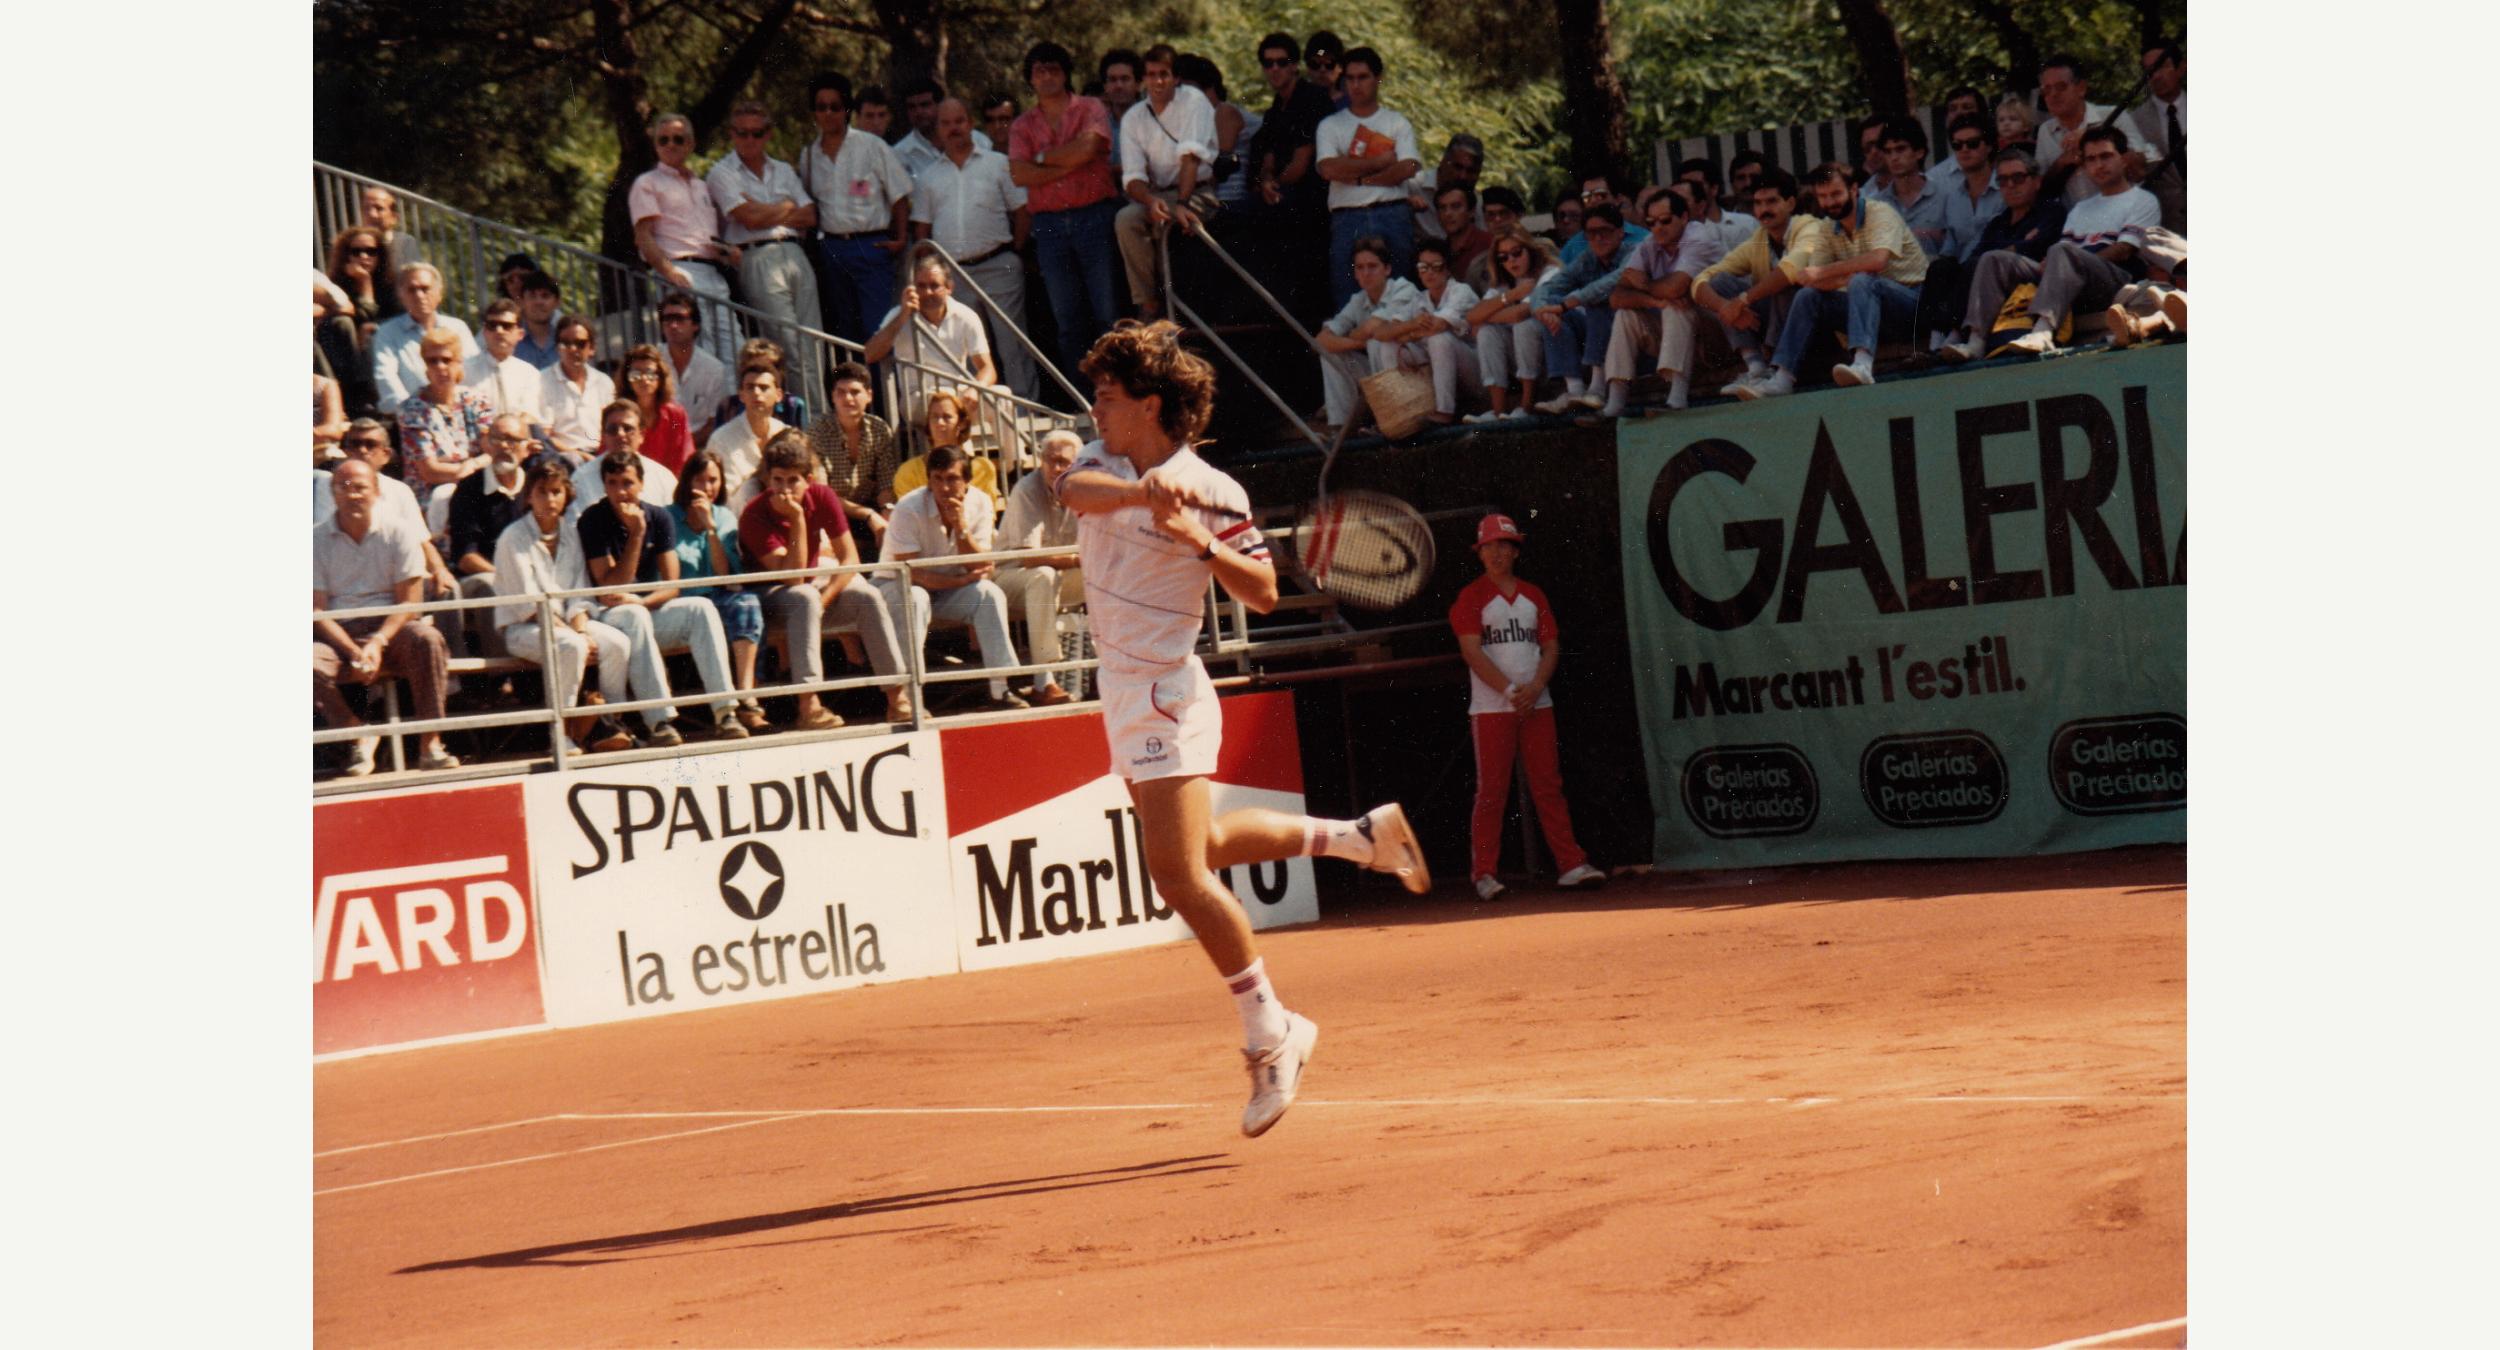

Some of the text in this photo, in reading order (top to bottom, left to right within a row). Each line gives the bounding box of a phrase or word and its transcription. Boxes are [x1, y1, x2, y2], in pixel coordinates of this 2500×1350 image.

[1672, 655, 1865, 720] Marcant
[566, 743, 918, 881] SPALDING
[1702, 793, 1806, 821] Preciados
[1879, 780, 1994, 812] Preciados
[2067, 763, 2187, 800] Preciado
[967, 806, 1289, 948] Marlbo
[617, 902, 886, 1006] la estrella
